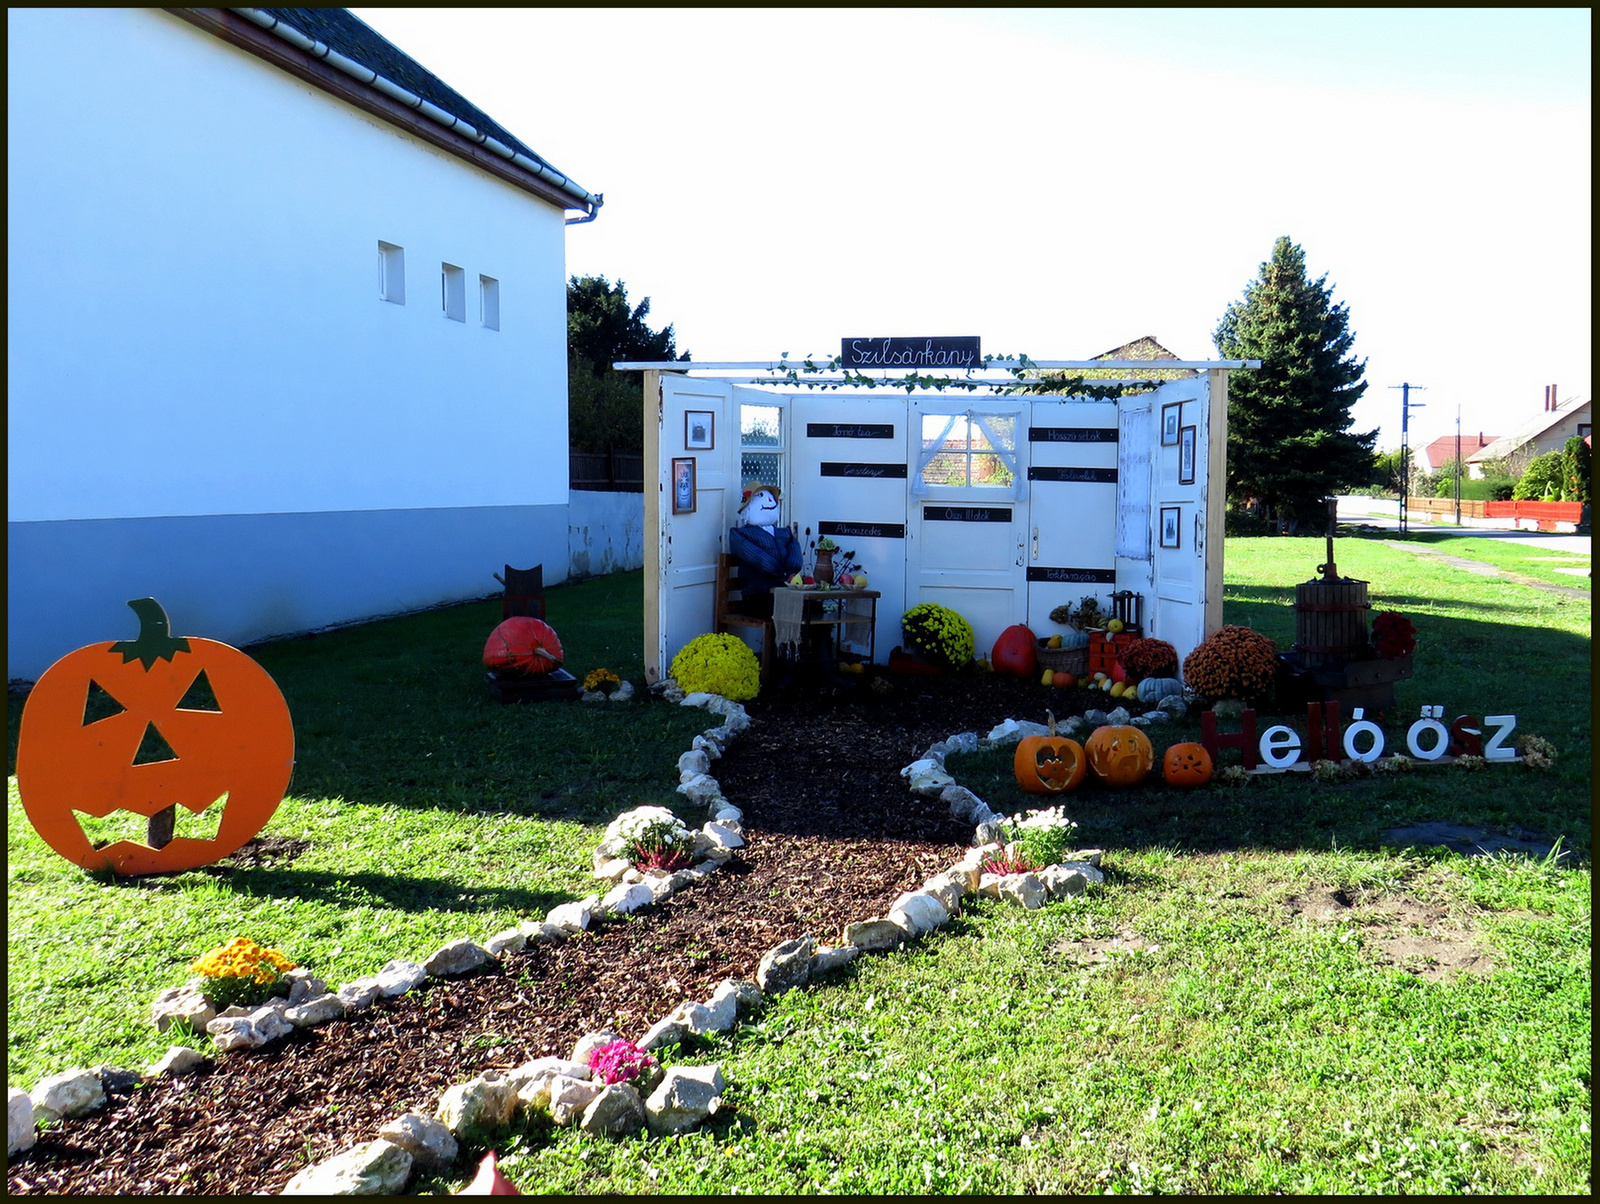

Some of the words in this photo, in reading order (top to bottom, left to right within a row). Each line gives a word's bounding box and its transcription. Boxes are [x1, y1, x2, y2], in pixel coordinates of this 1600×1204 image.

[851, 338, 975, 367] Szilsárkány
[835, 524, 881, 536] Almaszedés
[1201, 700, 1385, 770] Helló
